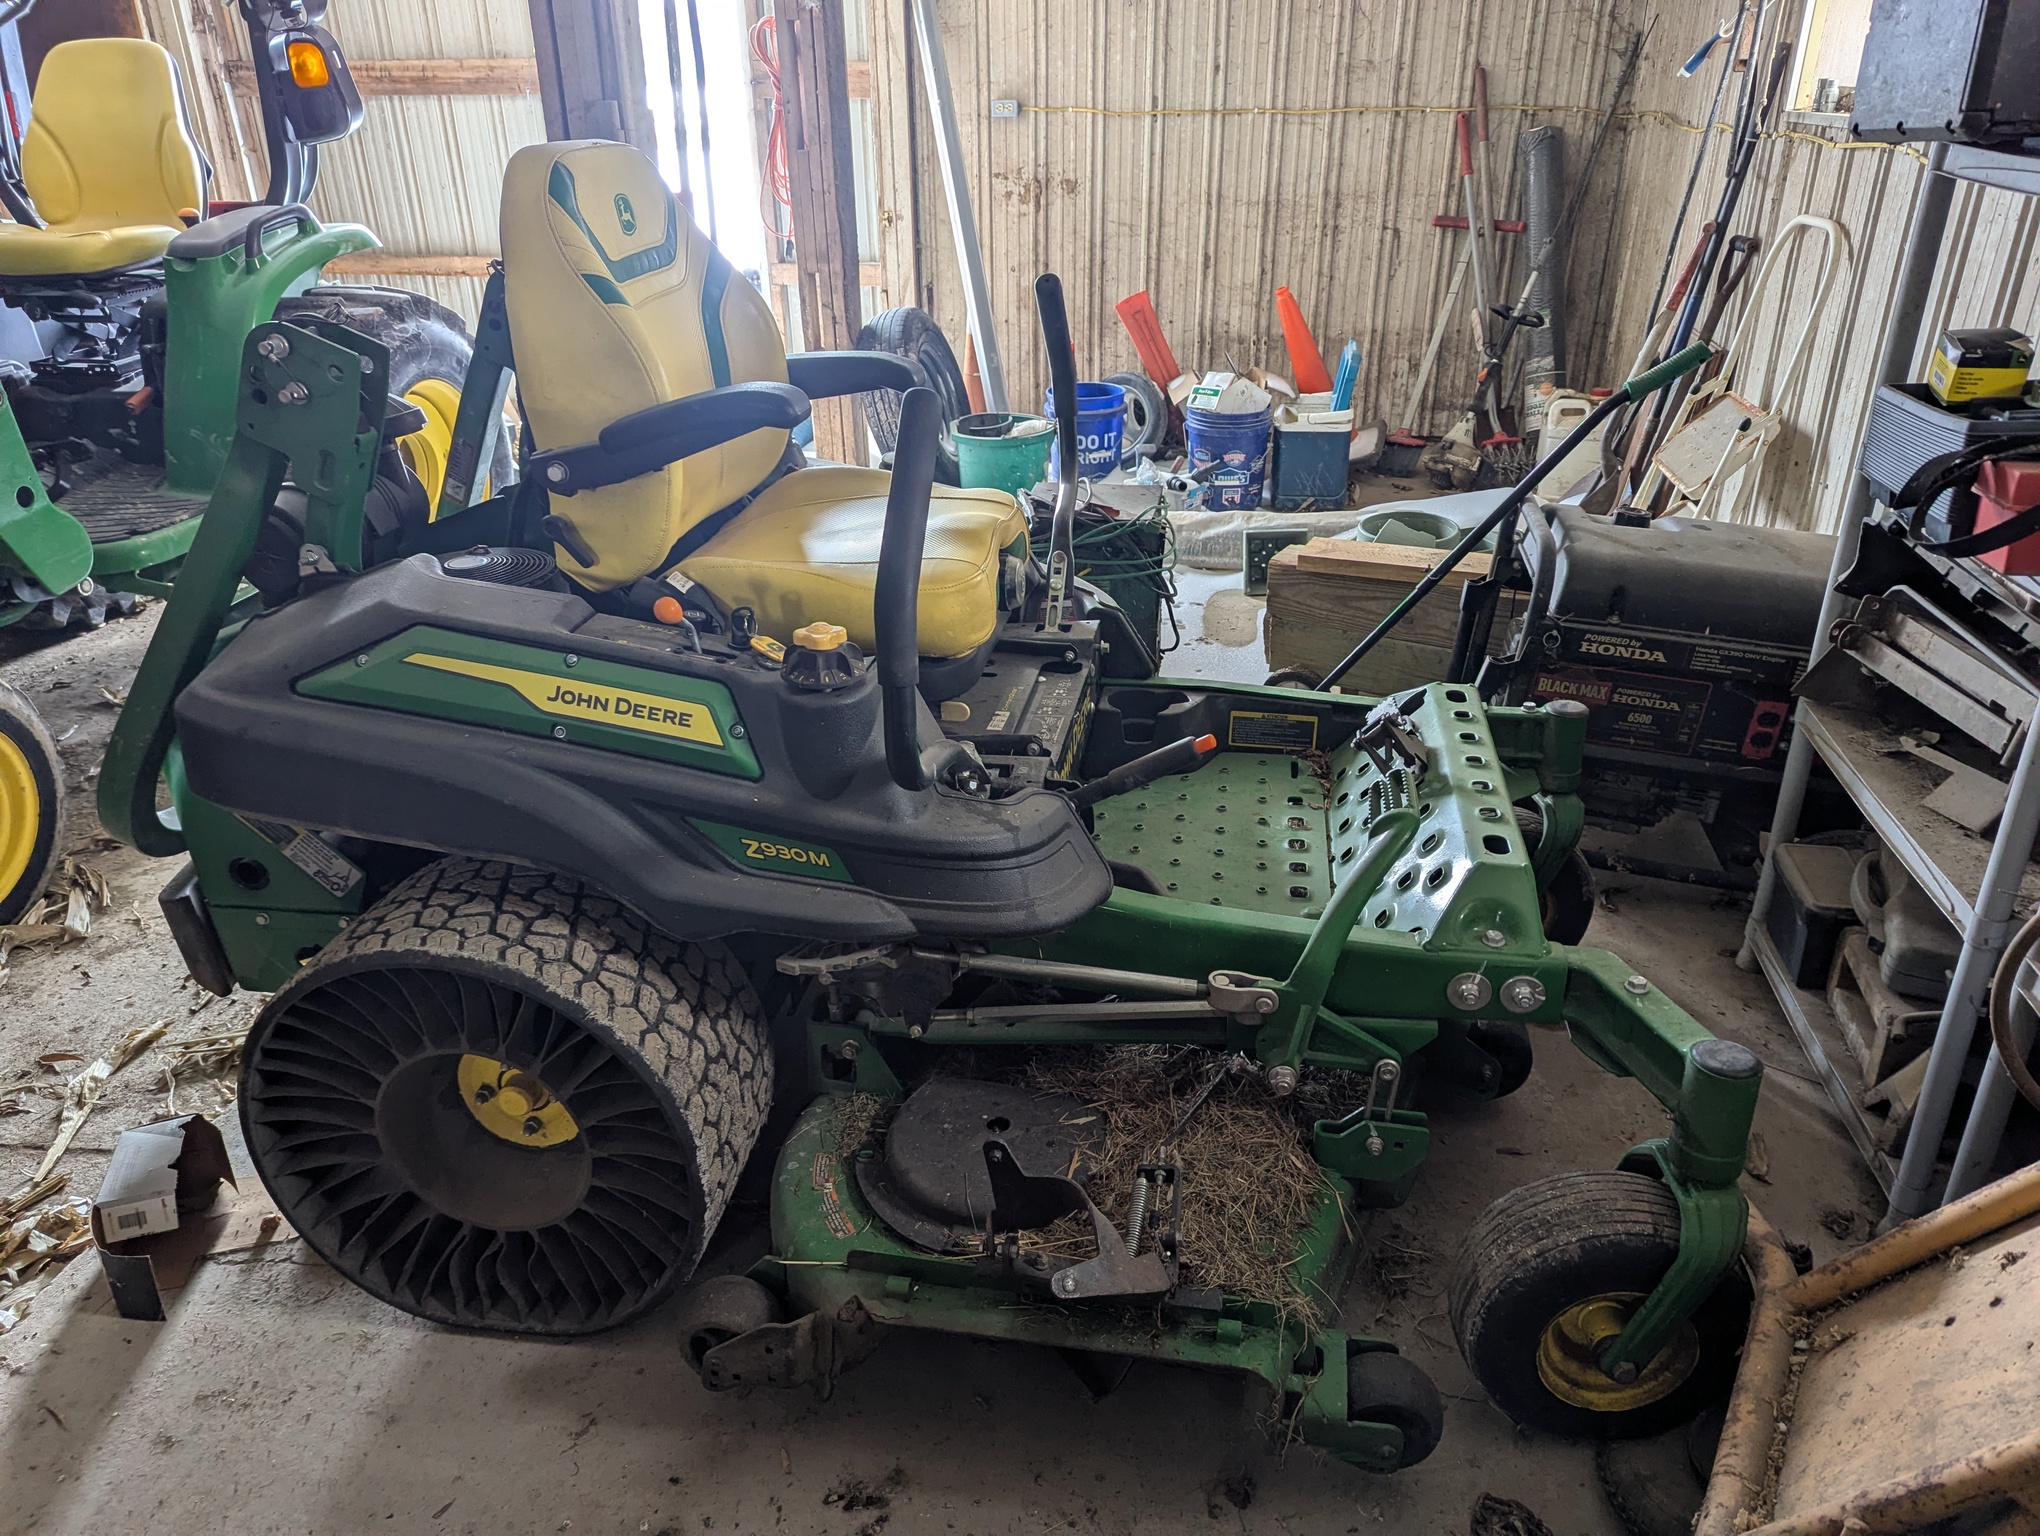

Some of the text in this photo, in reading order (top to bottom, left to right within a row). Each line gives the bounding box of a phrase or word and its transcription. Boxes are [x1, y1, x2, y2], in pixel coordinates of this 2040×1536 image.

[1077, 431, 1117, 450] DO IT
[1584, 633, 1642, 648] POWERED by
[1579, 641, 1668, 663] HONDA
[1537, 677, 1609, 701] BLACK MAX
[1616, 687, 1662, 700] POWERED by
[546, 685, 693, 728] JOHN DEERE
[1612, 693, 1681, 712] HONDA
[1627, 712, 1653, 725] 6500
[739, 837, 832, 868] Z930M
